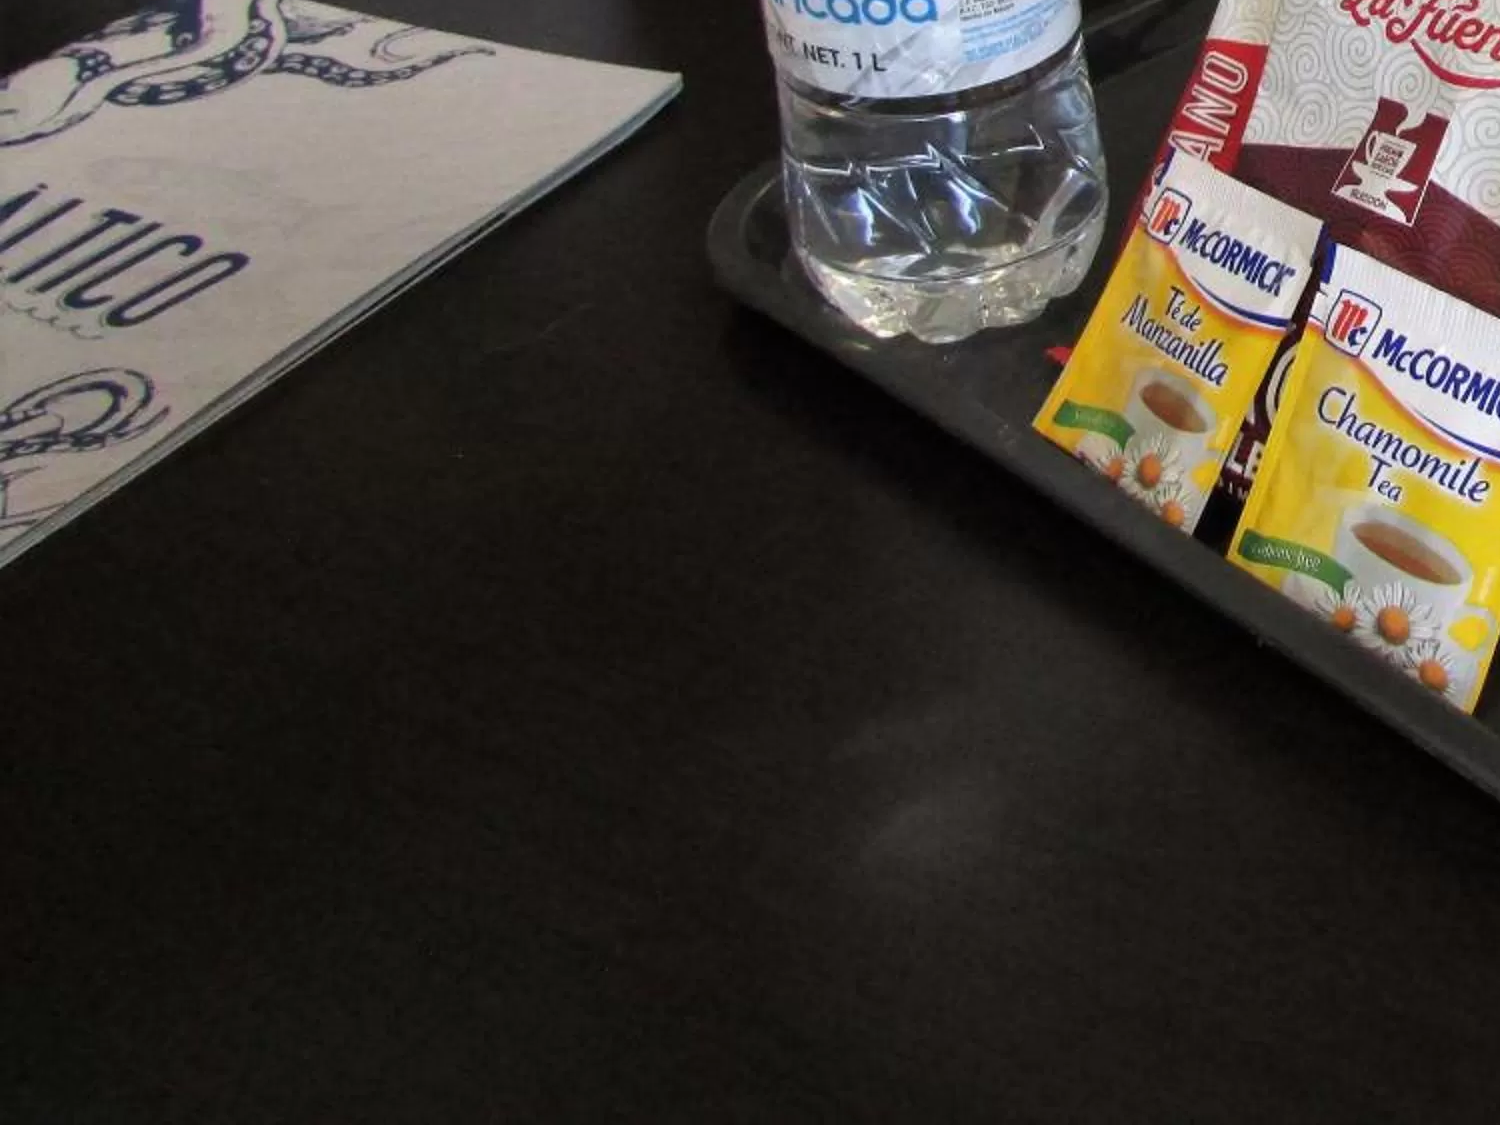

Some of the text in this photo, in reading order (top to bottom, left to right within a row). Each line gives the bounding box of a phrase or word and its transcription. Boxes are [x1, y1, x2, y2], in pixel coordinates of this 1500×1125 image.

[803, 42, 845, 68] NET.
[852, 53, 862, 70] 1
[872, 53, 887, 72] L
[1180, 218, 1295, 297] McCORMICK
[1170, 286, 1202, 331] Té de
[1121, 294, 1228, 387] Manzanilla
[1318, 386, 1491, 502] Chamomile
[1366, 454, 1403, 502] Tea
